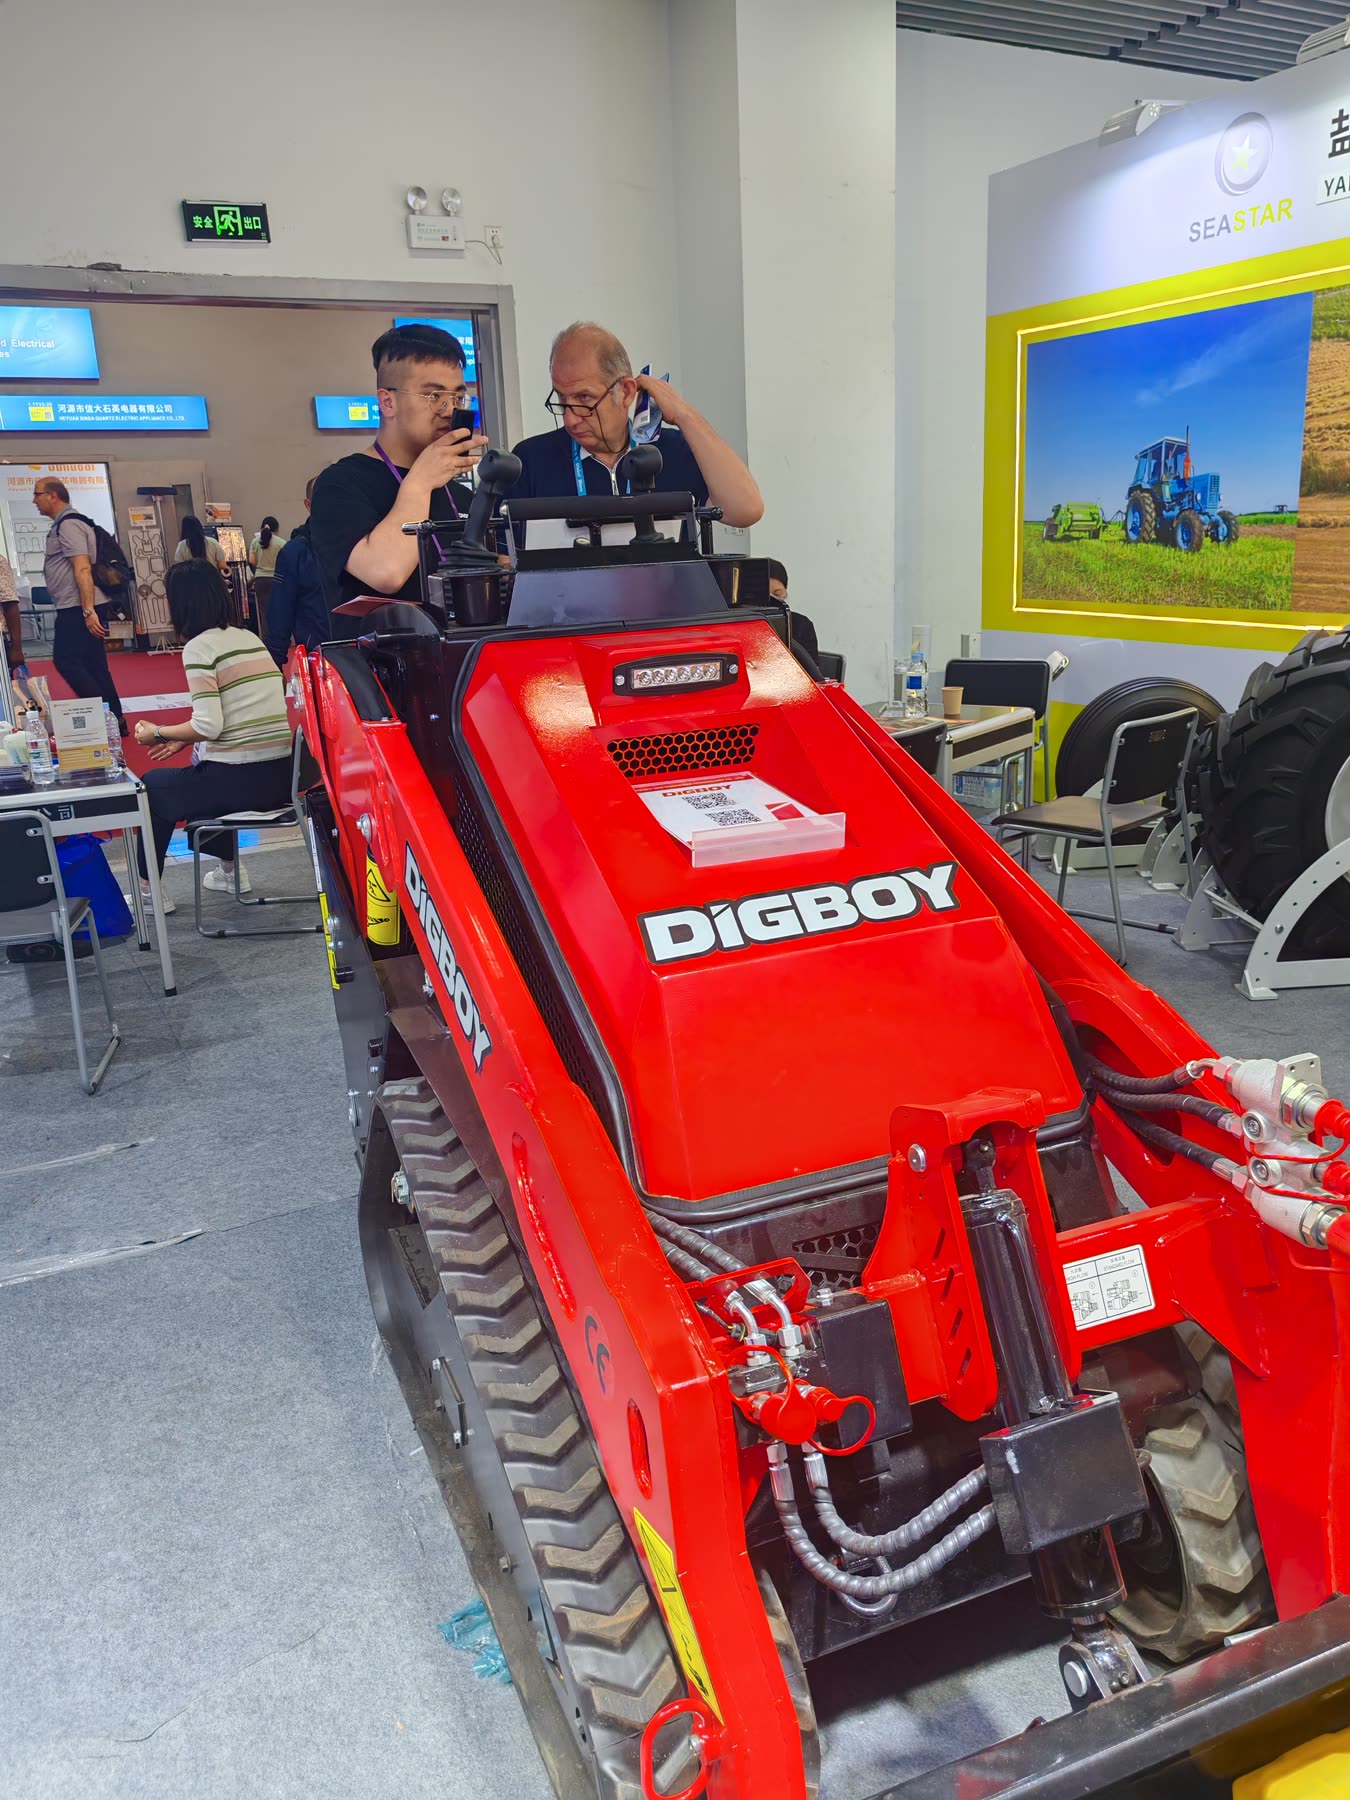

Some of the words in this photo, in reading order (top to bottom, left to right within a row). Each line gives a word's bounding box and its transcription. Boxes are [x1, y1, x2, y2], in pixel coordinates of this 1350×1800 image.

[193, 215, 213, 228] 安全
[243, 216, 262, 229] 出口
[1188, 197, 1293, 243] SEASTAR
[11, 339, 55, 348] Electrical
[57, 404, 173, 414] 河源市信大石英电器有限公司
